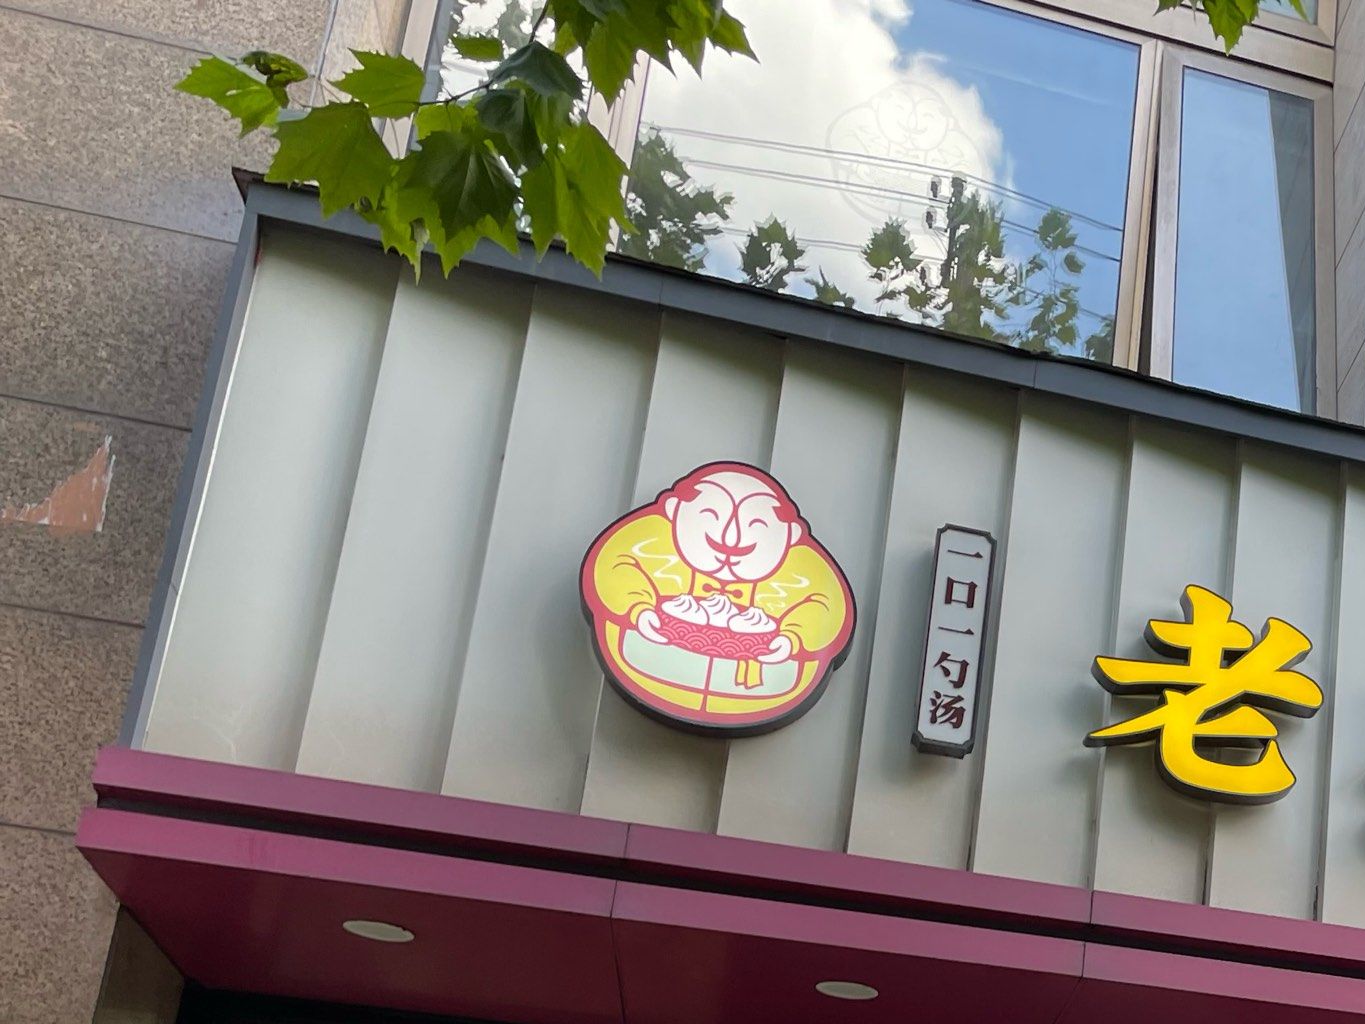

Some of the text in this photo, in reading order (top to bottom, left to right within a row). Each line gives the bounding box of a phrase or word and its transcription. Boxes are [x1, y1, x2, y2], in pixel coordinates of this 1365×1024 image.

[928, 548, 986, 731] 一口一勺汤
